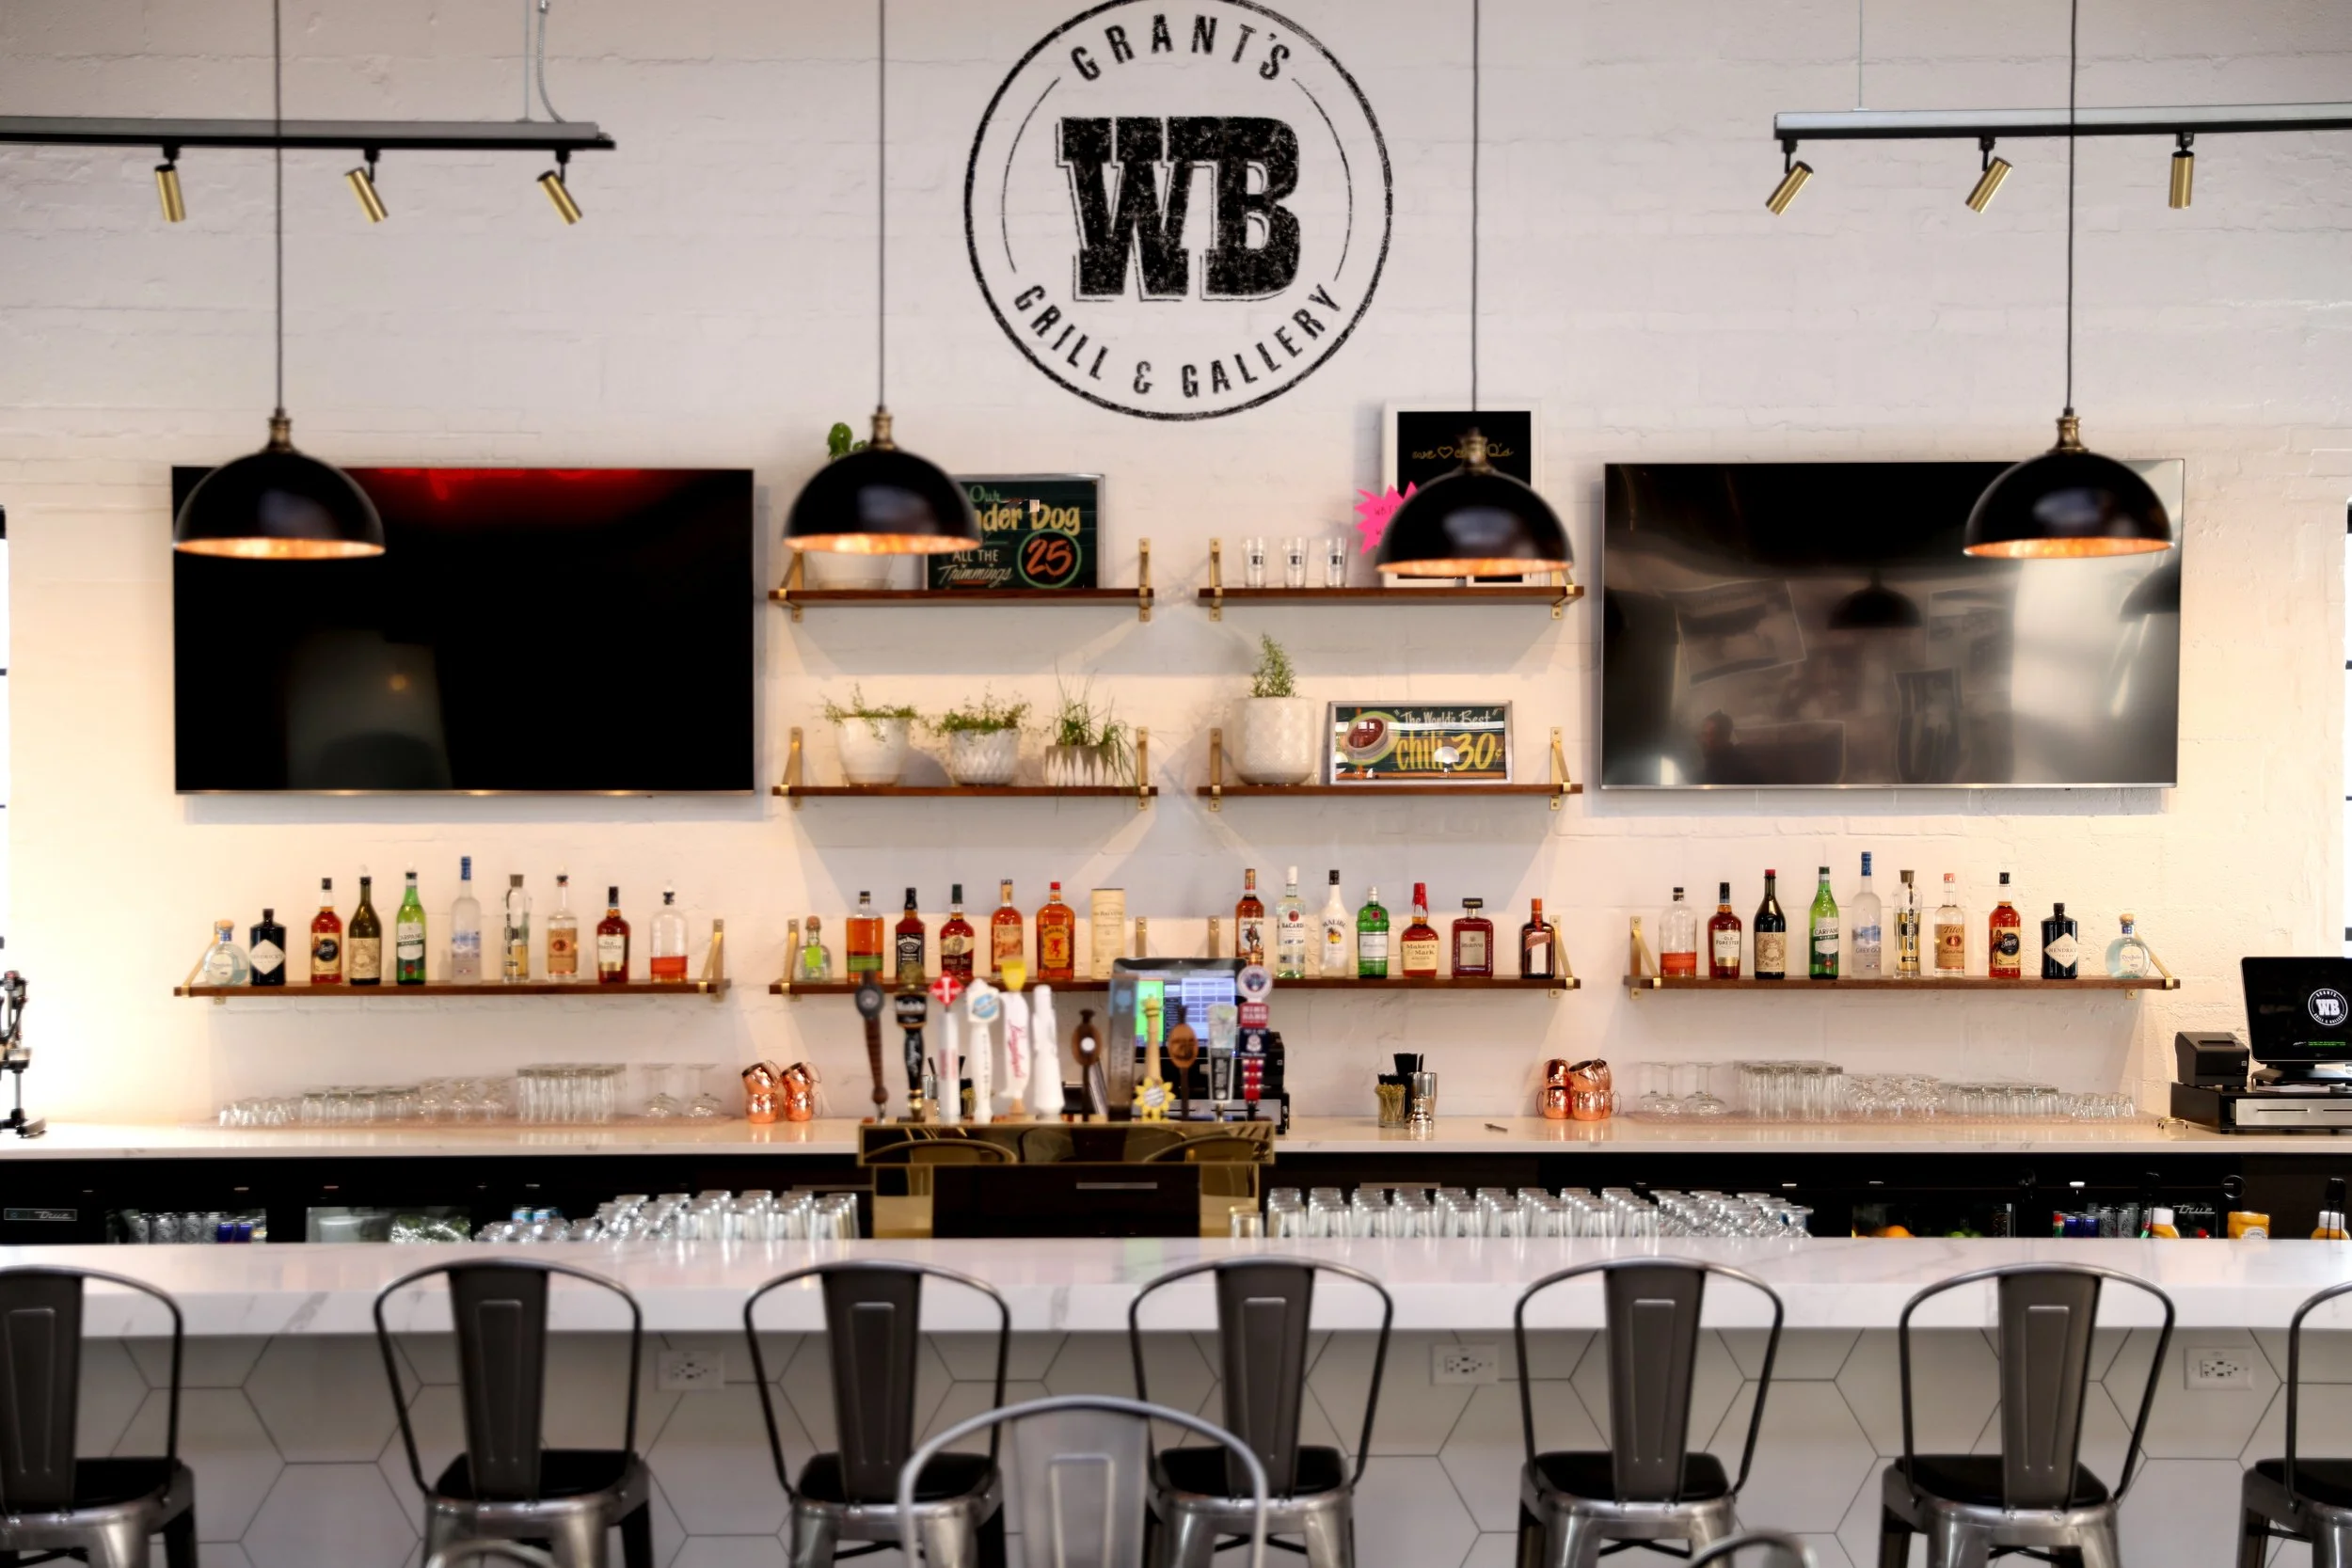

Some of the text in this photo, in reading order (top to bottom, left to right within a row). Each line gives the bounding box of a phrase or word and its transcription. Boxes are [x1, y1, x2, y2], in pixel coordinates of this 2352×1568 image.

[1071, 14, 1291, 81] GRANT'S
[1056, 116, 1301, 302] WB
[1014, 283, 1342, 398] GRILL & GALLERY
[1031, 503, 1081, 536] Dog
[952, 548, 1000, 562] ALL THE
[1025, 538, 1073, 577] 25
[937, 564, 1014, 589] Trimmings
[2315, 999, 2341, 1016] WB
